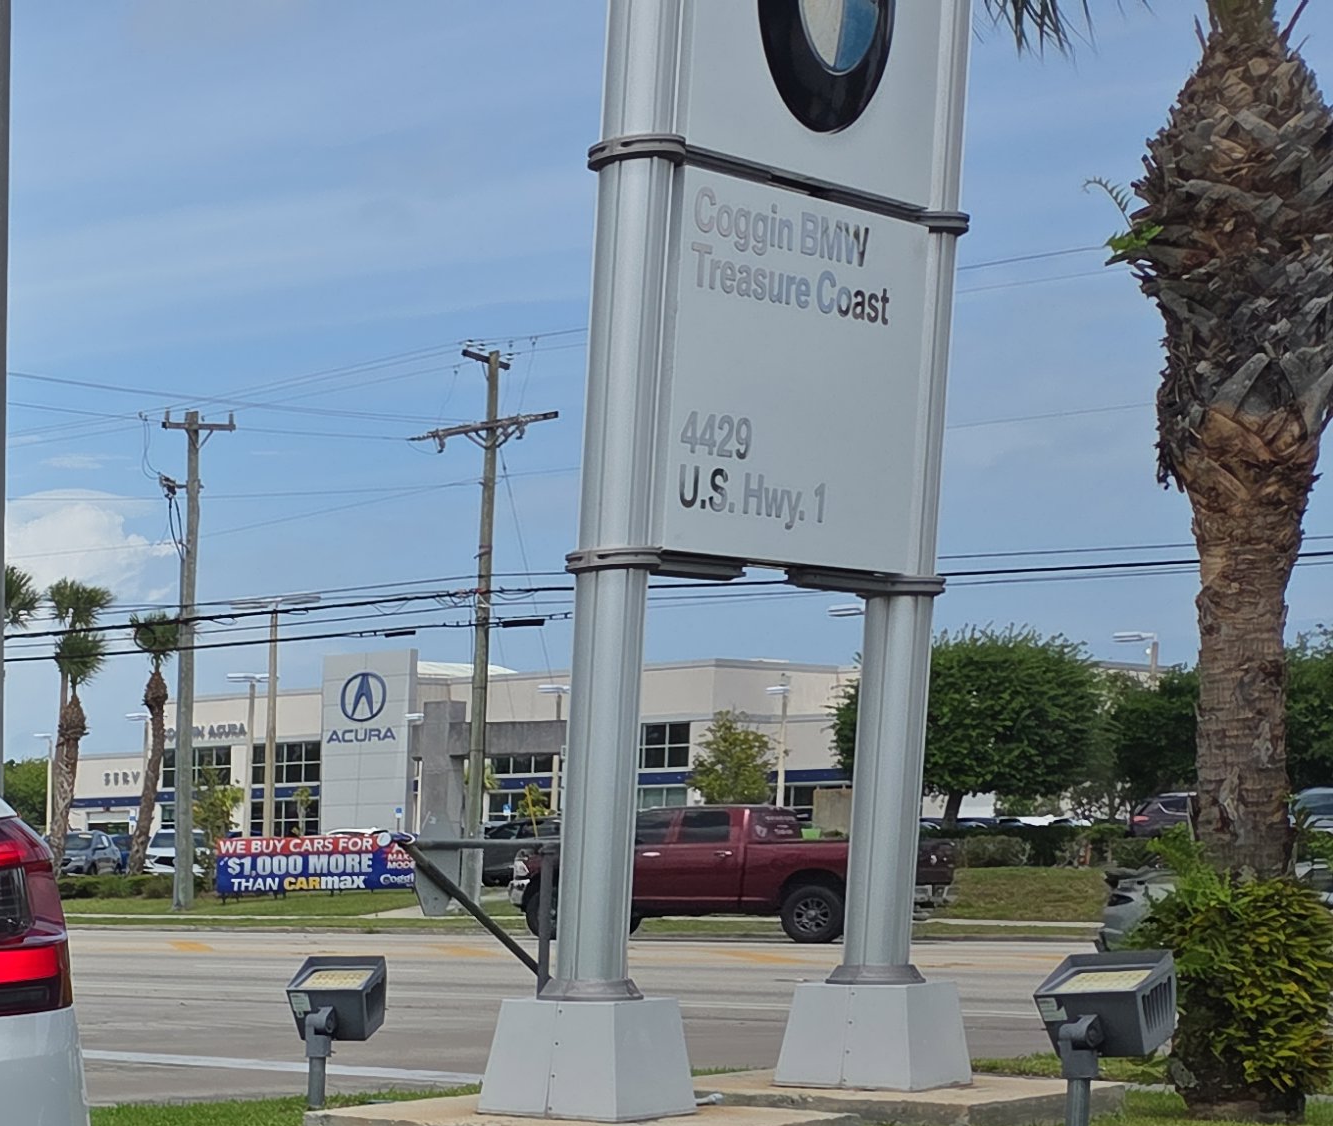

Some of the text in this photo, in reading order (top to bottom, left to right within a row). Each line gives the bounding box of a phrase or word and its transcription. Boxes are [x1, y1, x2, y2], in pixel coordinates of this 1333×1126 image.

[694, 186, 869, 267] Coggin BMW
[691, 241, 889, 325] Treasure Coast
[680, 411, 752, 460] 4429
[679, 464, 827, 530] U.S. Hwy. 1
[326, 727, 396, 744] ACURA
[219, 837, 373, 854] WE BUY CARS FOR
[227, 855, 303, 877] $1,000
[308, 853, 373, 874] MORE
[230, 877, 279, 891] THAN
